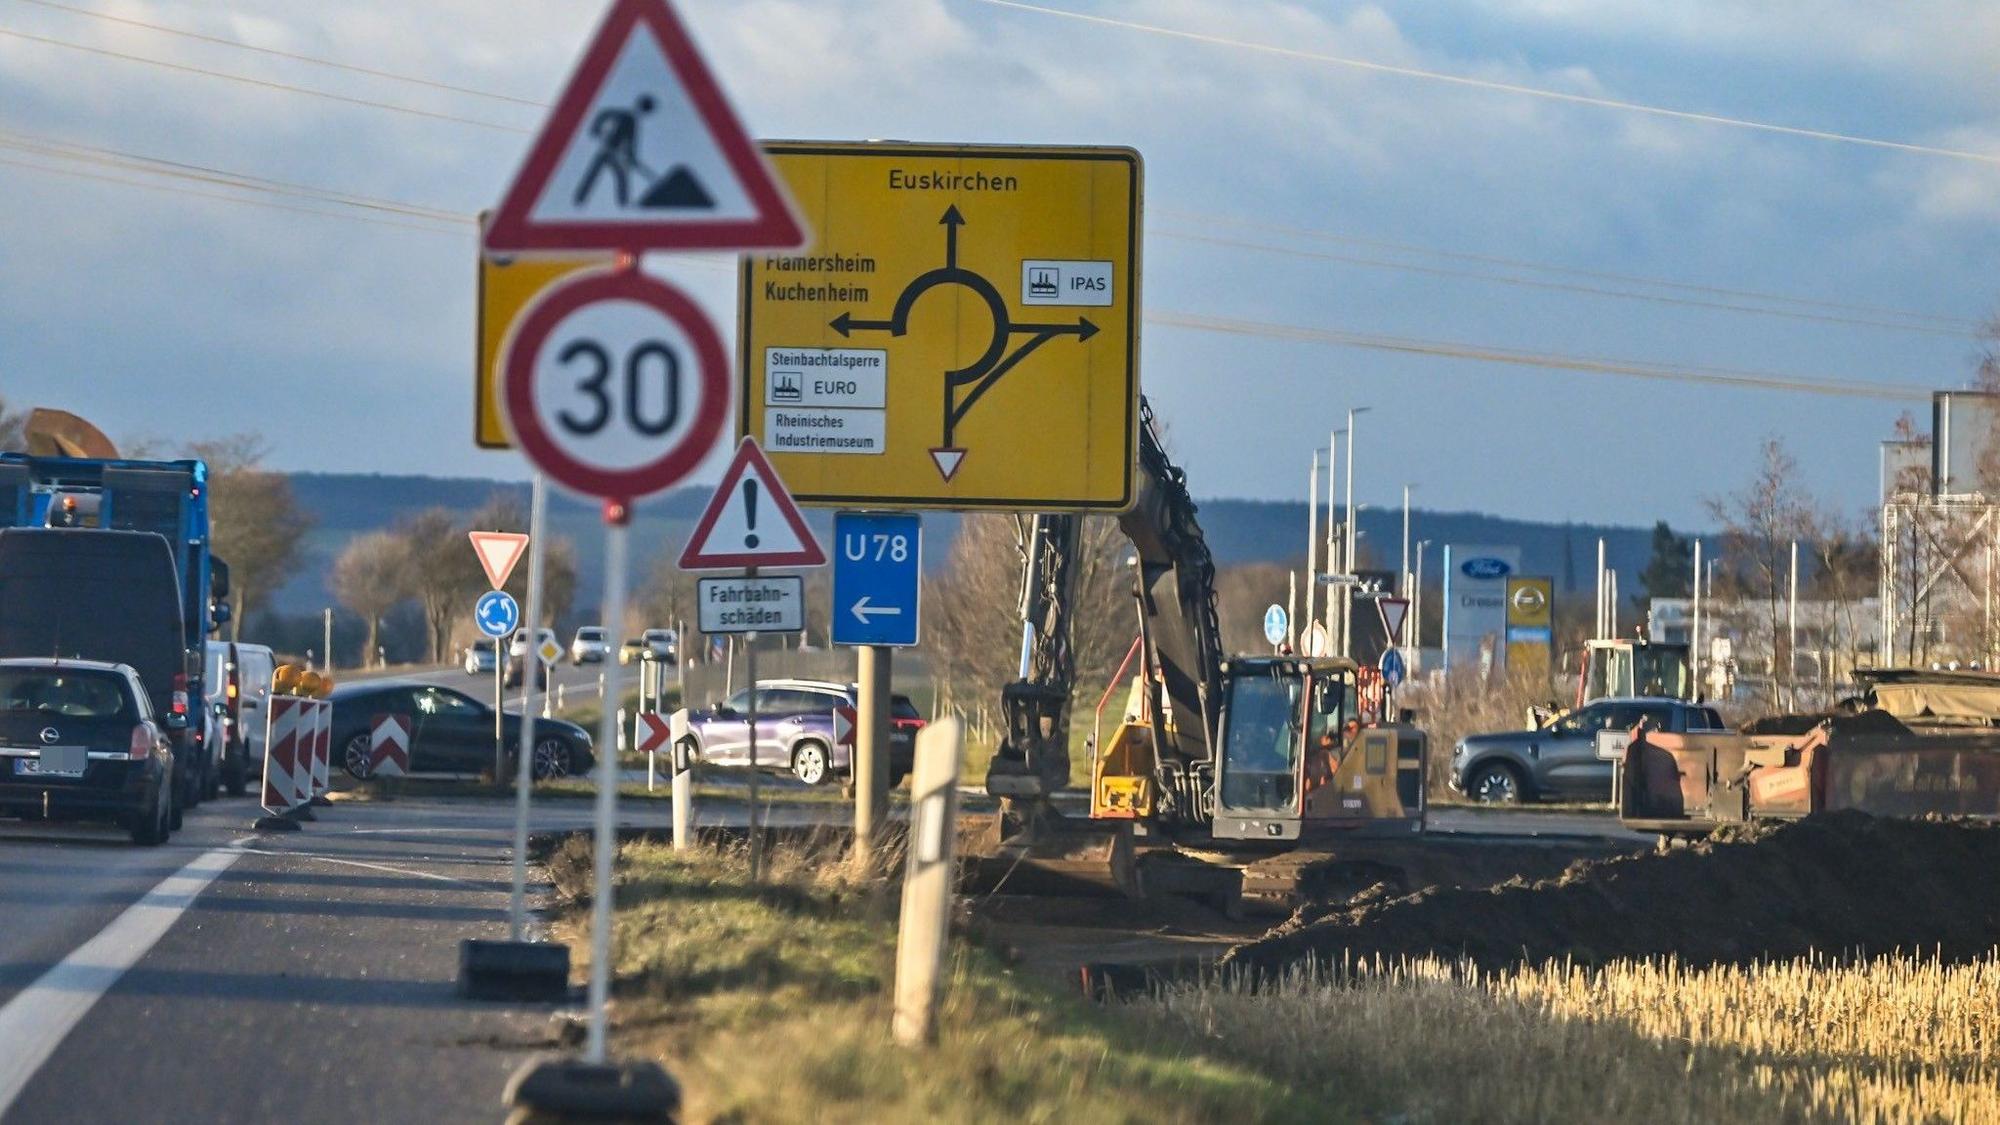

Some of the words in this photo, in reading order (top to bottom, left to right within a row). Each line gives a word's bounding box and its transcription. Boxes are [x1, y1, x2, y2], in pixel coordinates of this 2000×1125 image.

[889, 170, 1018, 192] Euskirchen
[765, 281, 869, 303] Kuchenheim
[1070, 277, 1106, 291] IPAS
[772, 353, 880, 370] Steinbachtalsperre
[556, 338, 680, 436] 30
[814, 381, 857, 395] EURO
[775, 414, 844, 429] Rheinisches
[775, 433, 874, 449] Industriemuseum
[845, 534, 866, 562] U
[873, 534, 908, 563] 78
[710, 586, 790, 603] Fahrbahn-
[719, 607, 782, 625] schäden
